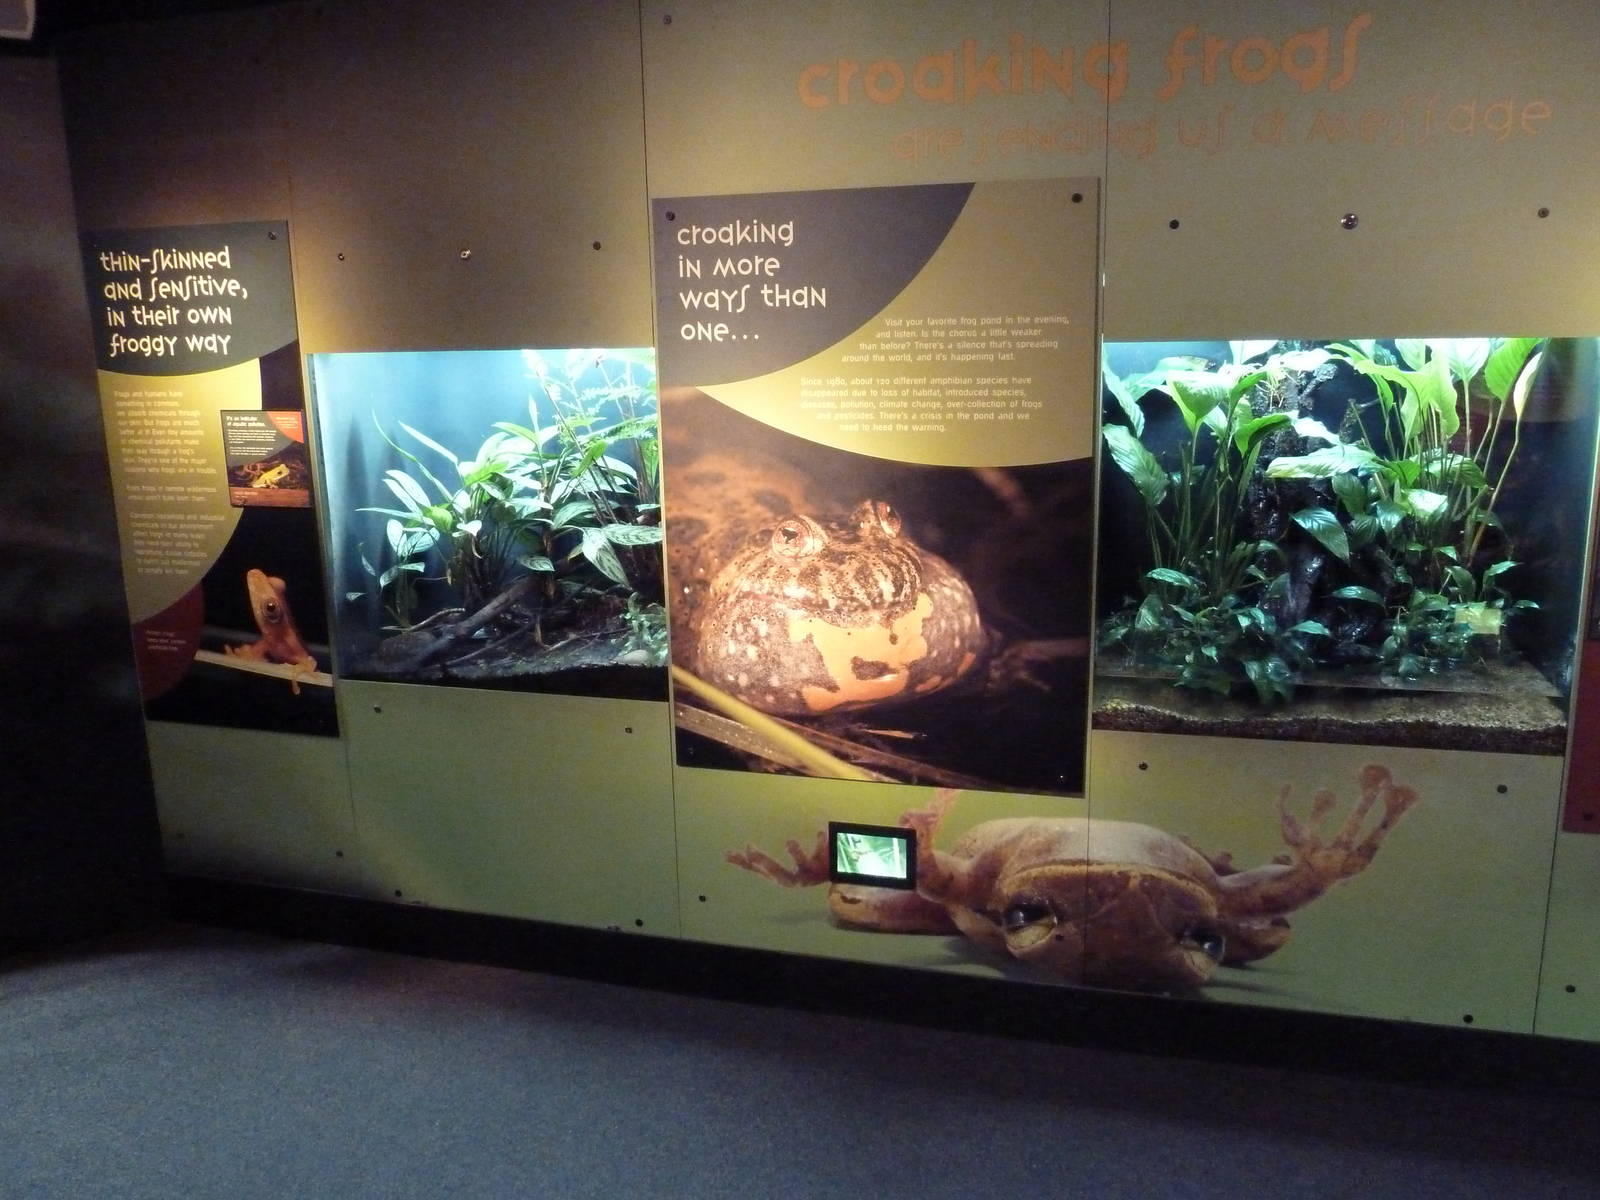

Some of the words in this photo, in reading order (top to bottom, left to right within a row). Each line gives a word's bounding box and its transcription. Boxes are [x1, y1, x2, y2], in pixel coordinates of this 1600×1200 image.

[798, 33, 1129, 108] croaking
[1157, 12, 1372, 102] frogs
[1178, 102, 1234, 151] us
[1251, 112, 1288, 144] a
[677, 219, 794, 248] croaking
[100, 245, 231, 275] thin-skinned
[678, 254, 701, 280] in
[713, 255, 782, 278] more
[104, 277, 142, 301] and
[149, 274, 249, 303] sensitive,
[679, 283, 751, 314] ways
[760, 283, 827, 310] than
[106, 306, 127, 328] in
[131, 304, 181, 327] their
[187, 305, 233, 326] own
[885, 319, 902, 327] Visit
[906, 319, 923, 327] your
[927, 317, 957, 326] favorite
[961, 317, 977, 326] frog
[980, 316, 1001, 325] pond
[1017, 316, 1031, 324] the
[1034, 316, 1070, 325] evening,
[679, 321, 760, 343] one...
[876, 330, 890, 338] and
[895, 330, 918, 338] listen.
[921, 330, 929, 338] Is
[990, 328, 1007, 336] little
[1011, 328, 1041, 336] weaker
[109, 332, 178, 358] froggy
[185, 333, 232, 356] way
[881, 342, 911, 350] before?
[914, 341, 944, 350] There's
[956, 341, 986, 349] silence
[1015, 341, 1058, 350] spreading
[889, 354, 913, 363] world,
[917, 353, 932, 361] and
[936, 353, 948, 361] it's
[951, 353, 994, 362] happening
[998, 353, 1015, 361] fast.
[851, 377, 873, 385] about
[893, 377, 927, 385] different
[930, 377, 972, 386] amphibian
[975, 377, 1009, 386] species
[852, 389, 867, 397] due
[870, 389, 878, 397] to
[882, 389, 898, 397] loss
[912, 389, 942, 397] habitat,
[945, 388, 988, 397] introduced
[992, 389, 1026, 398] species,
[840, 400, 876, 409] pollution,
[879, 400, 908, 409] climate
[911, 400, 943, 410] change,
[946, 400, 1006, 409] over-collection
[1010, 400, 1018, 408] of
[1021, 400, 1042, 409] frogs
[879, 411, 909, 420] There's
[920, 411, 942, 420] crisis
[945, 412, 954, 420] in
[956, 411, 970, 420] the
[973, 411, 995, 421] pond
[998, 411, 1014, 420] and
[1017, 412, 1030, 420] we
[873, 423, 893, 431] heed
[911, 424, 945, 432] warning.
